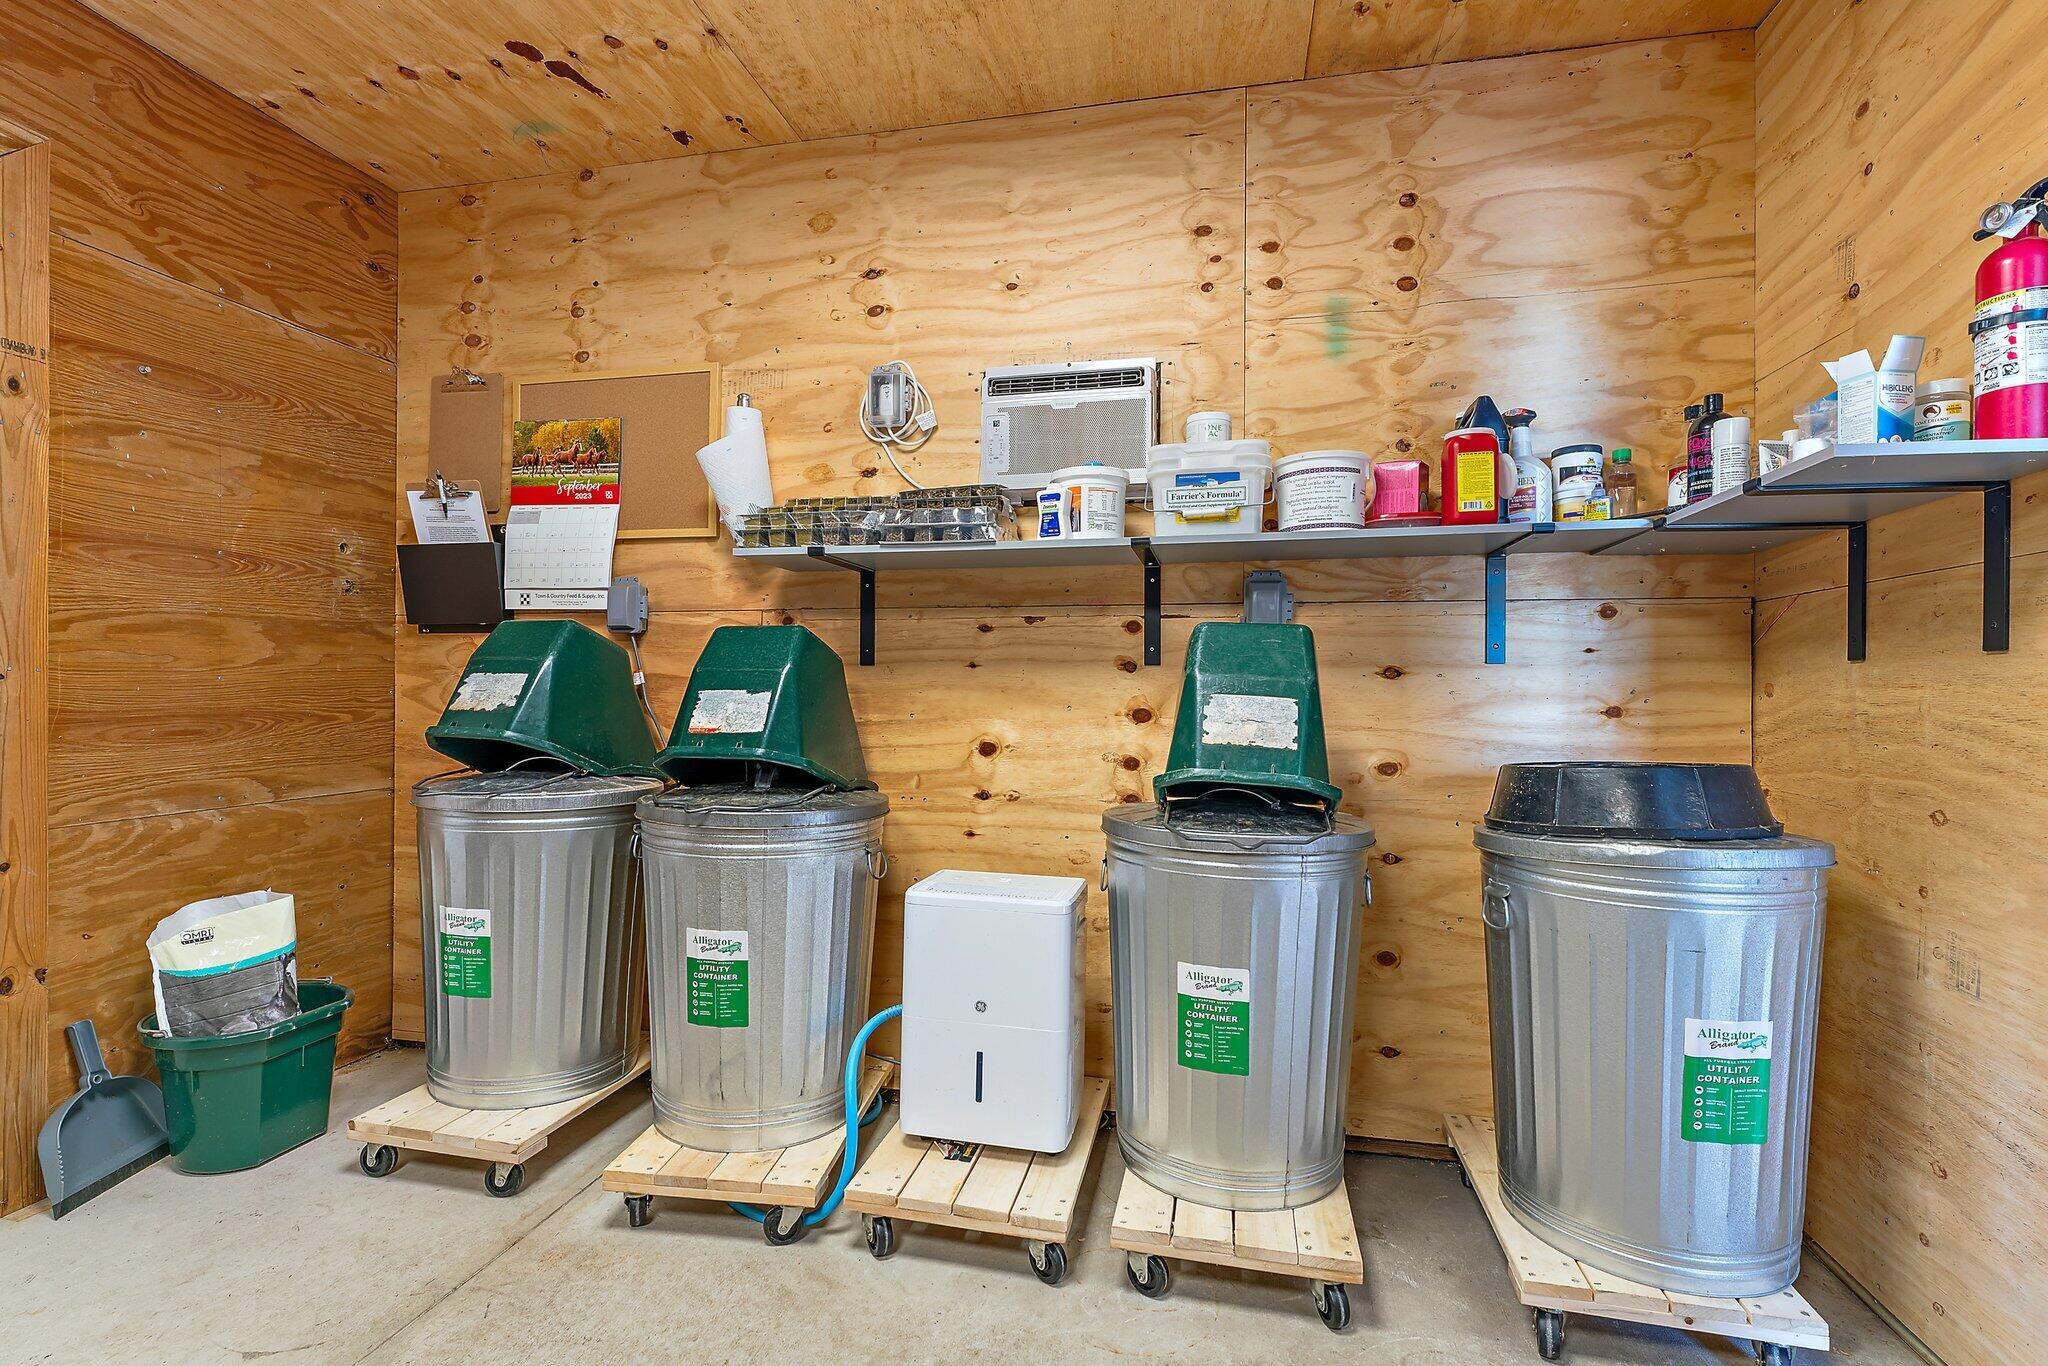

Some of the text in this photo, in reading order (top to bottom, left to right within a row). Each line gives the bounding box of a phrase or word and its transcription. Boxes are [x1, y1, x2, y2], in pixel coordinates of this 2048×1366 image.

[1882, 384, 1914, 394] HIBICLENS
[556, 478, 602, 496] September
[1171, 490, 1205, 500] Farrier's
[444, 914, 478, 923] Alligator
[182, 928, 212, 940] OMRI
[692, 936, 732, 946] Alligator
[445, 946, 482, 955] CONTAINER
[700, 945, 718, 953] Brand
[700, 964, 730, 972] UTILITY
[694, 972, 738, 981] CONTAINER
[1185, 971, 1232, 984] Alligator
[1194, 982, 1217, 990] Brand
[1194, 1002, 1230, 1013] UTILITY
[1187, 1010, 1238, 1023] CONTAINER
[1697, 1028, 1756, 1041] Alligator
[1709, 1040, 1739, 1050] Brand
[1708, 1064, 1751, 1074] UTILITY
[1697, 1074, 1760, 1084] CONTAINER
